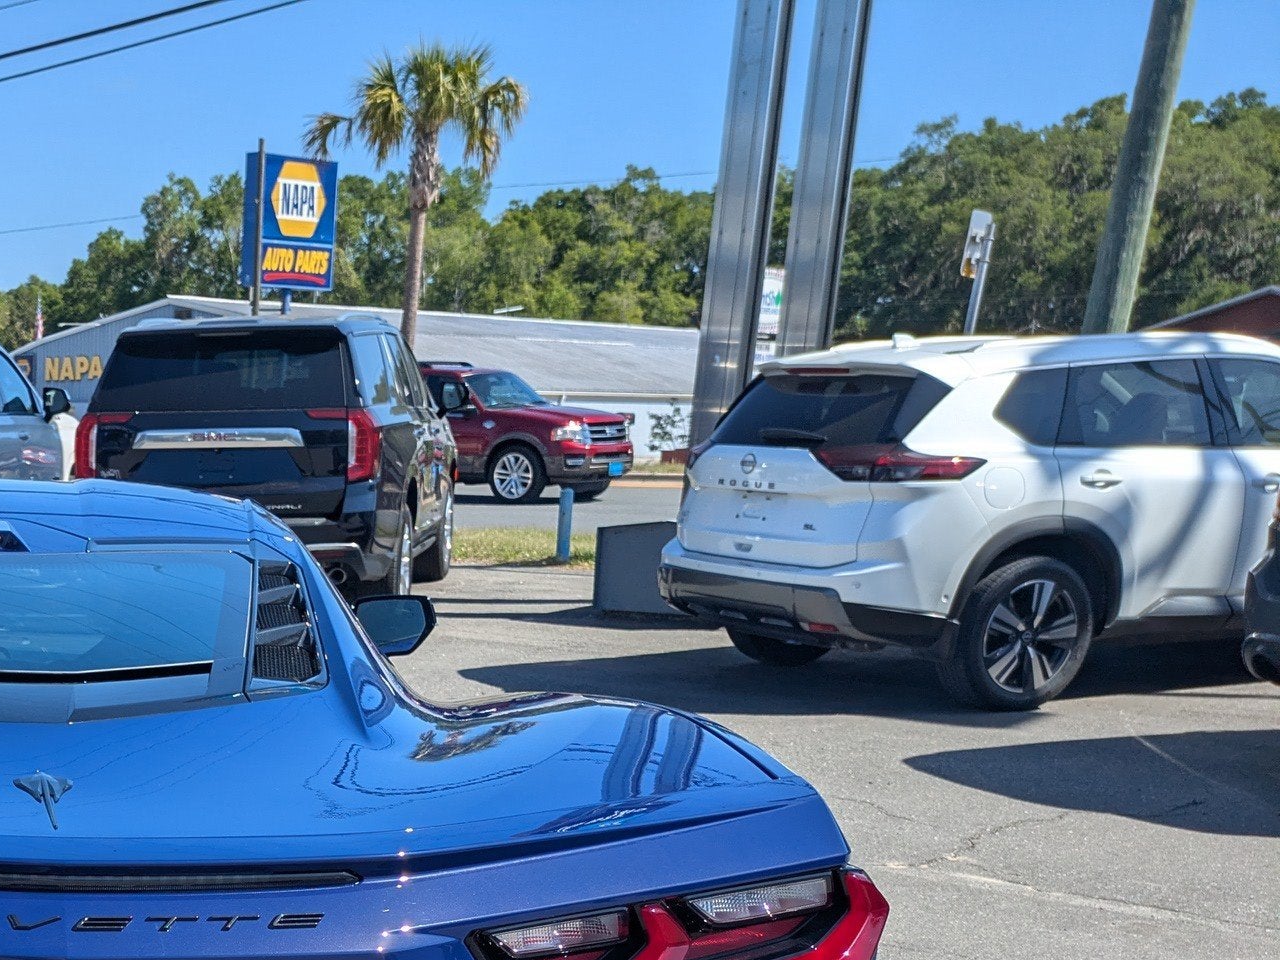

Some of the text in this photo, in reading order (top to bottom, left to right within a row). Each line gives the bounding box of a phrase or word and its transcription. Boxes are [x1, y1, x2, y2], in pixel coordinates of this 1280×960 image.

[281, 183, 315, 217] NAPA
[262, 247, 329, 275] AUTO PARTS
[45, 355, 104, 381] NAPA
[718, 478, 776, 490] ROGUE
[803, 523, 816, 531] SL
